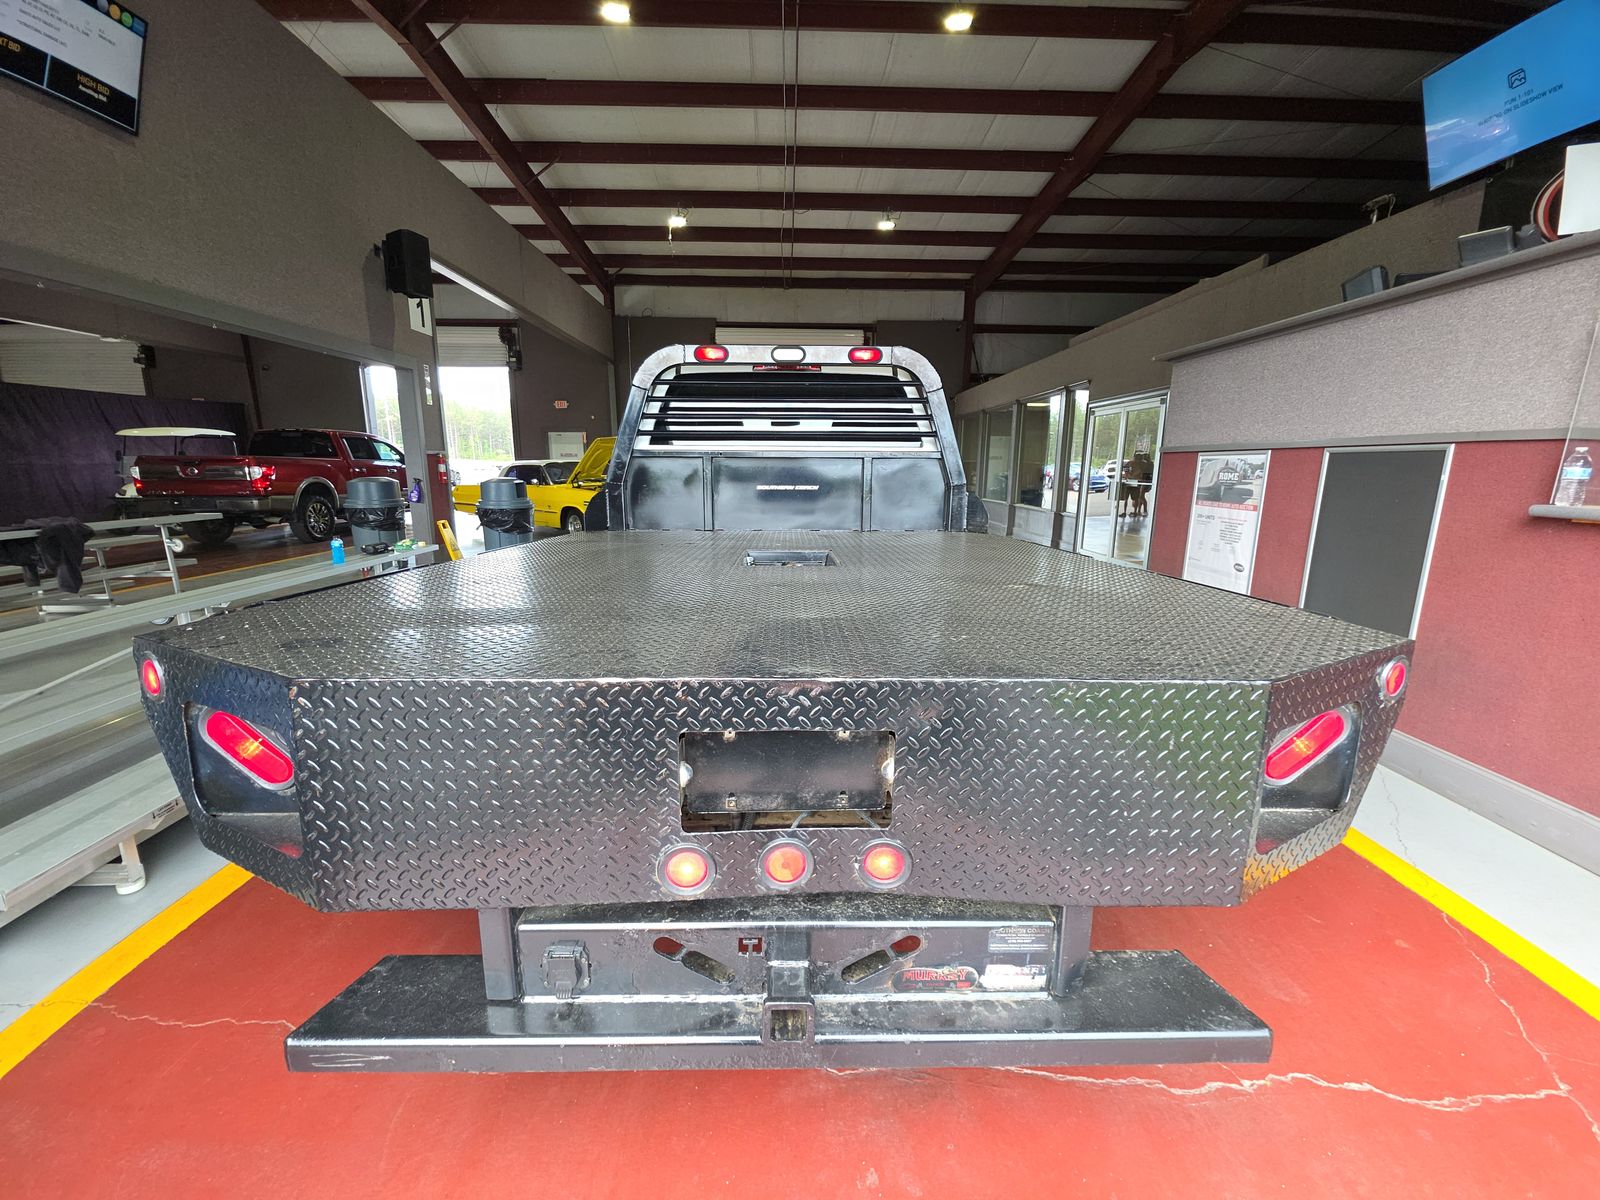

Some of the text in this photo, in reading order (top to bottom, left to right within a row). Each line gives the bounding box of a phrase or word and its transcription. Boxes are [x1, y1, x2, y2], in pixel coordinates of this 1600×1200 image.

[8, 41, 21, 53] BID
[77, 73, 110, 96] HIGH BID
[1512, 91, 1547, 111] SLIDESHOW
[1548, 83, 1564, 95] VIEW
[416, 299, 426, 329] 1
